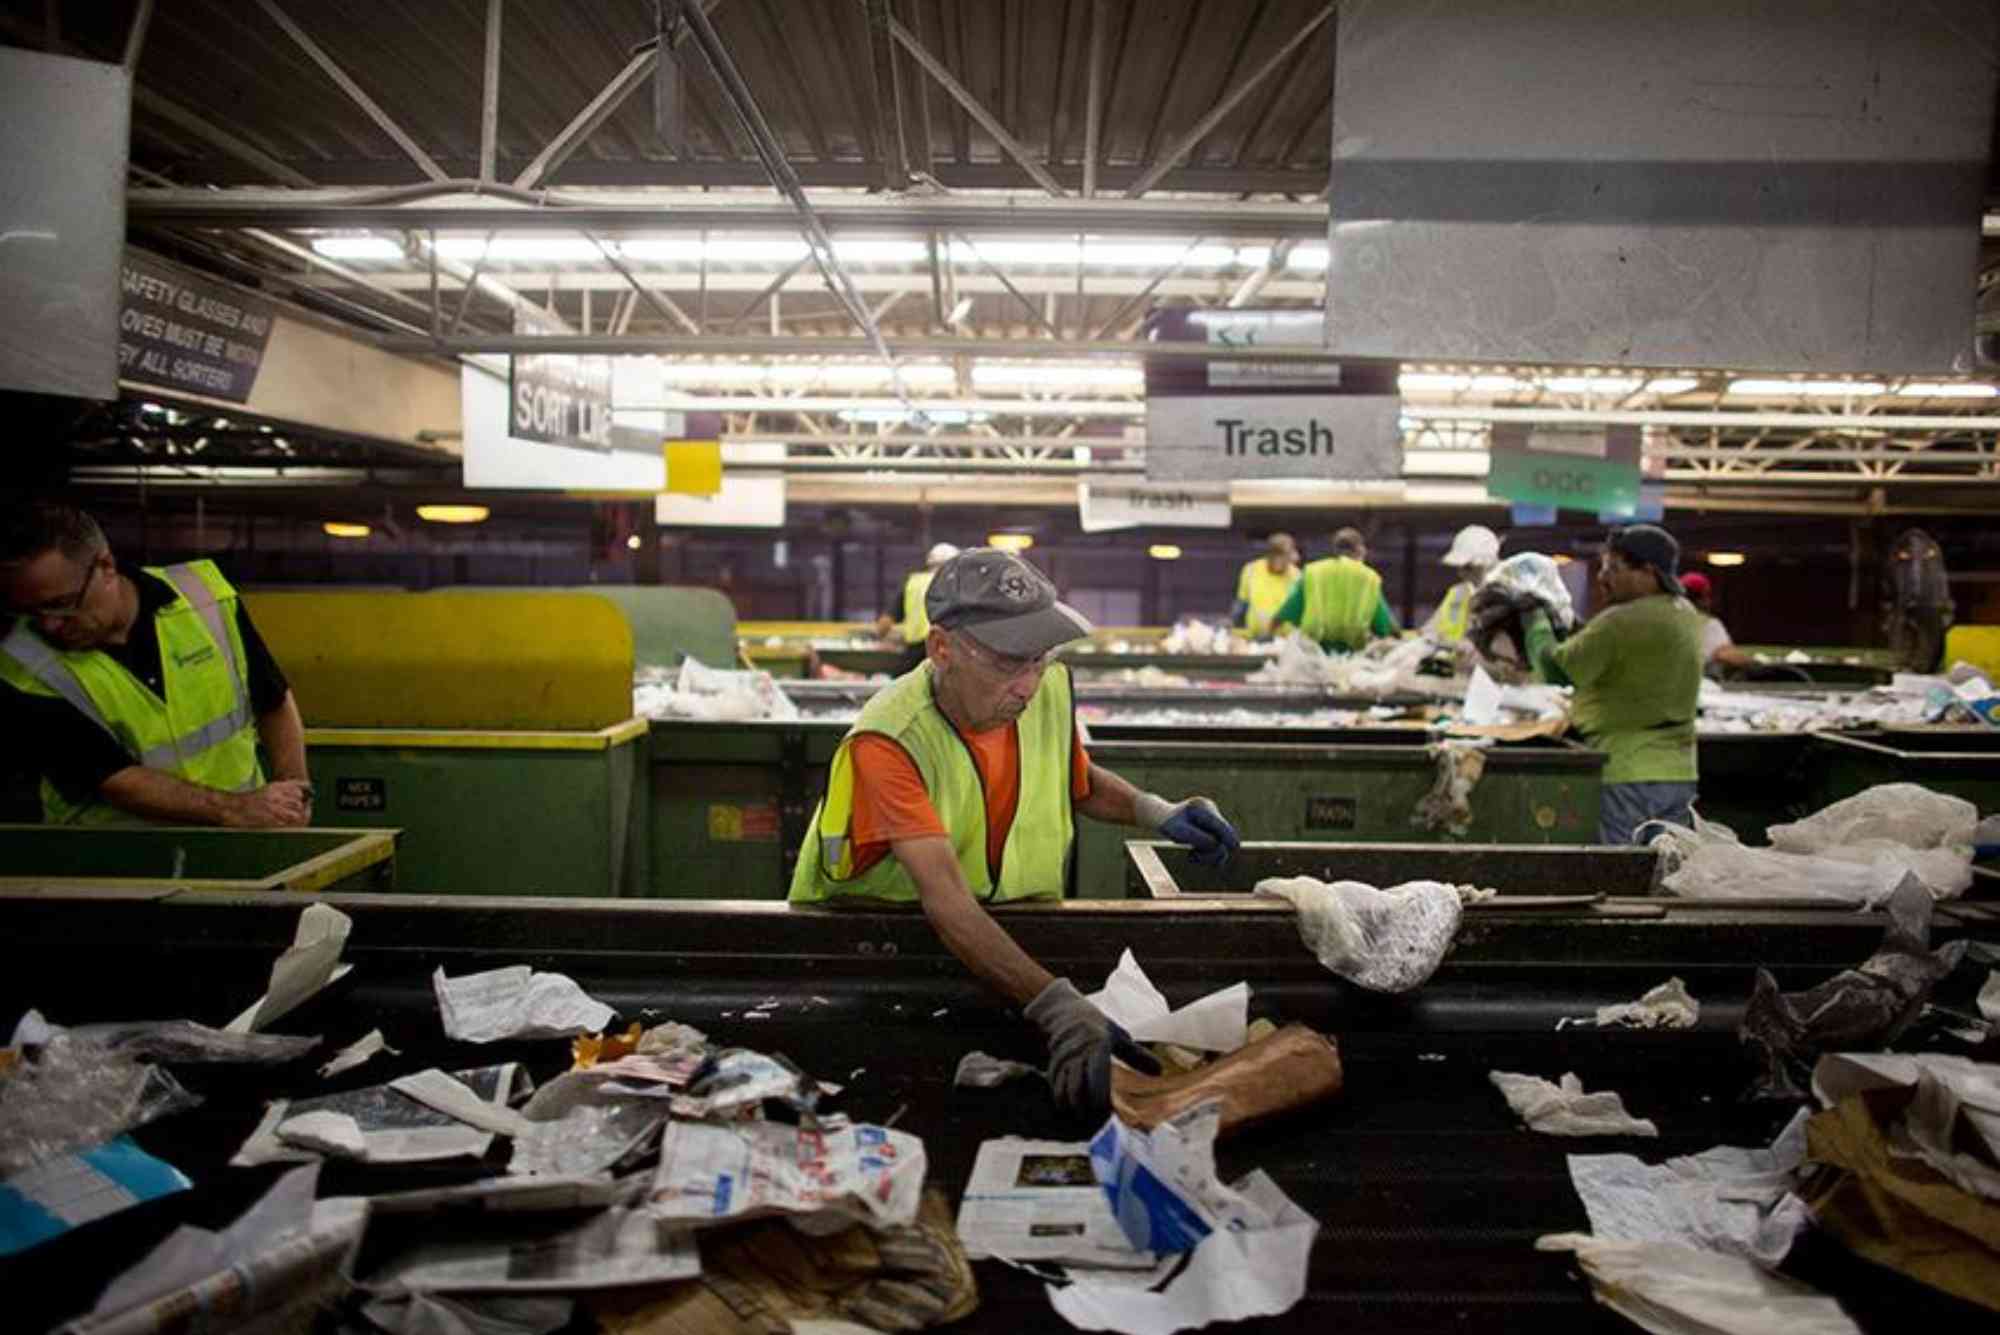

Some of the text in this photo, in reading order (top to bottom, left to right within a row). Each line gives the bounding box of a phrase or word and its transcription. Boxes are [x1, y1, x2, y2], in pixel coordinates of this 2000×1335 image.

[120, 308, 166, 339] OVES
[165, 321, 206, 349] MUST
[203, 335, 225, 357] BE
[139, 351, 169, 375] ALL
[516, 382, 572, 437] SORT
[1215, 418, 1334, 456] Trash
